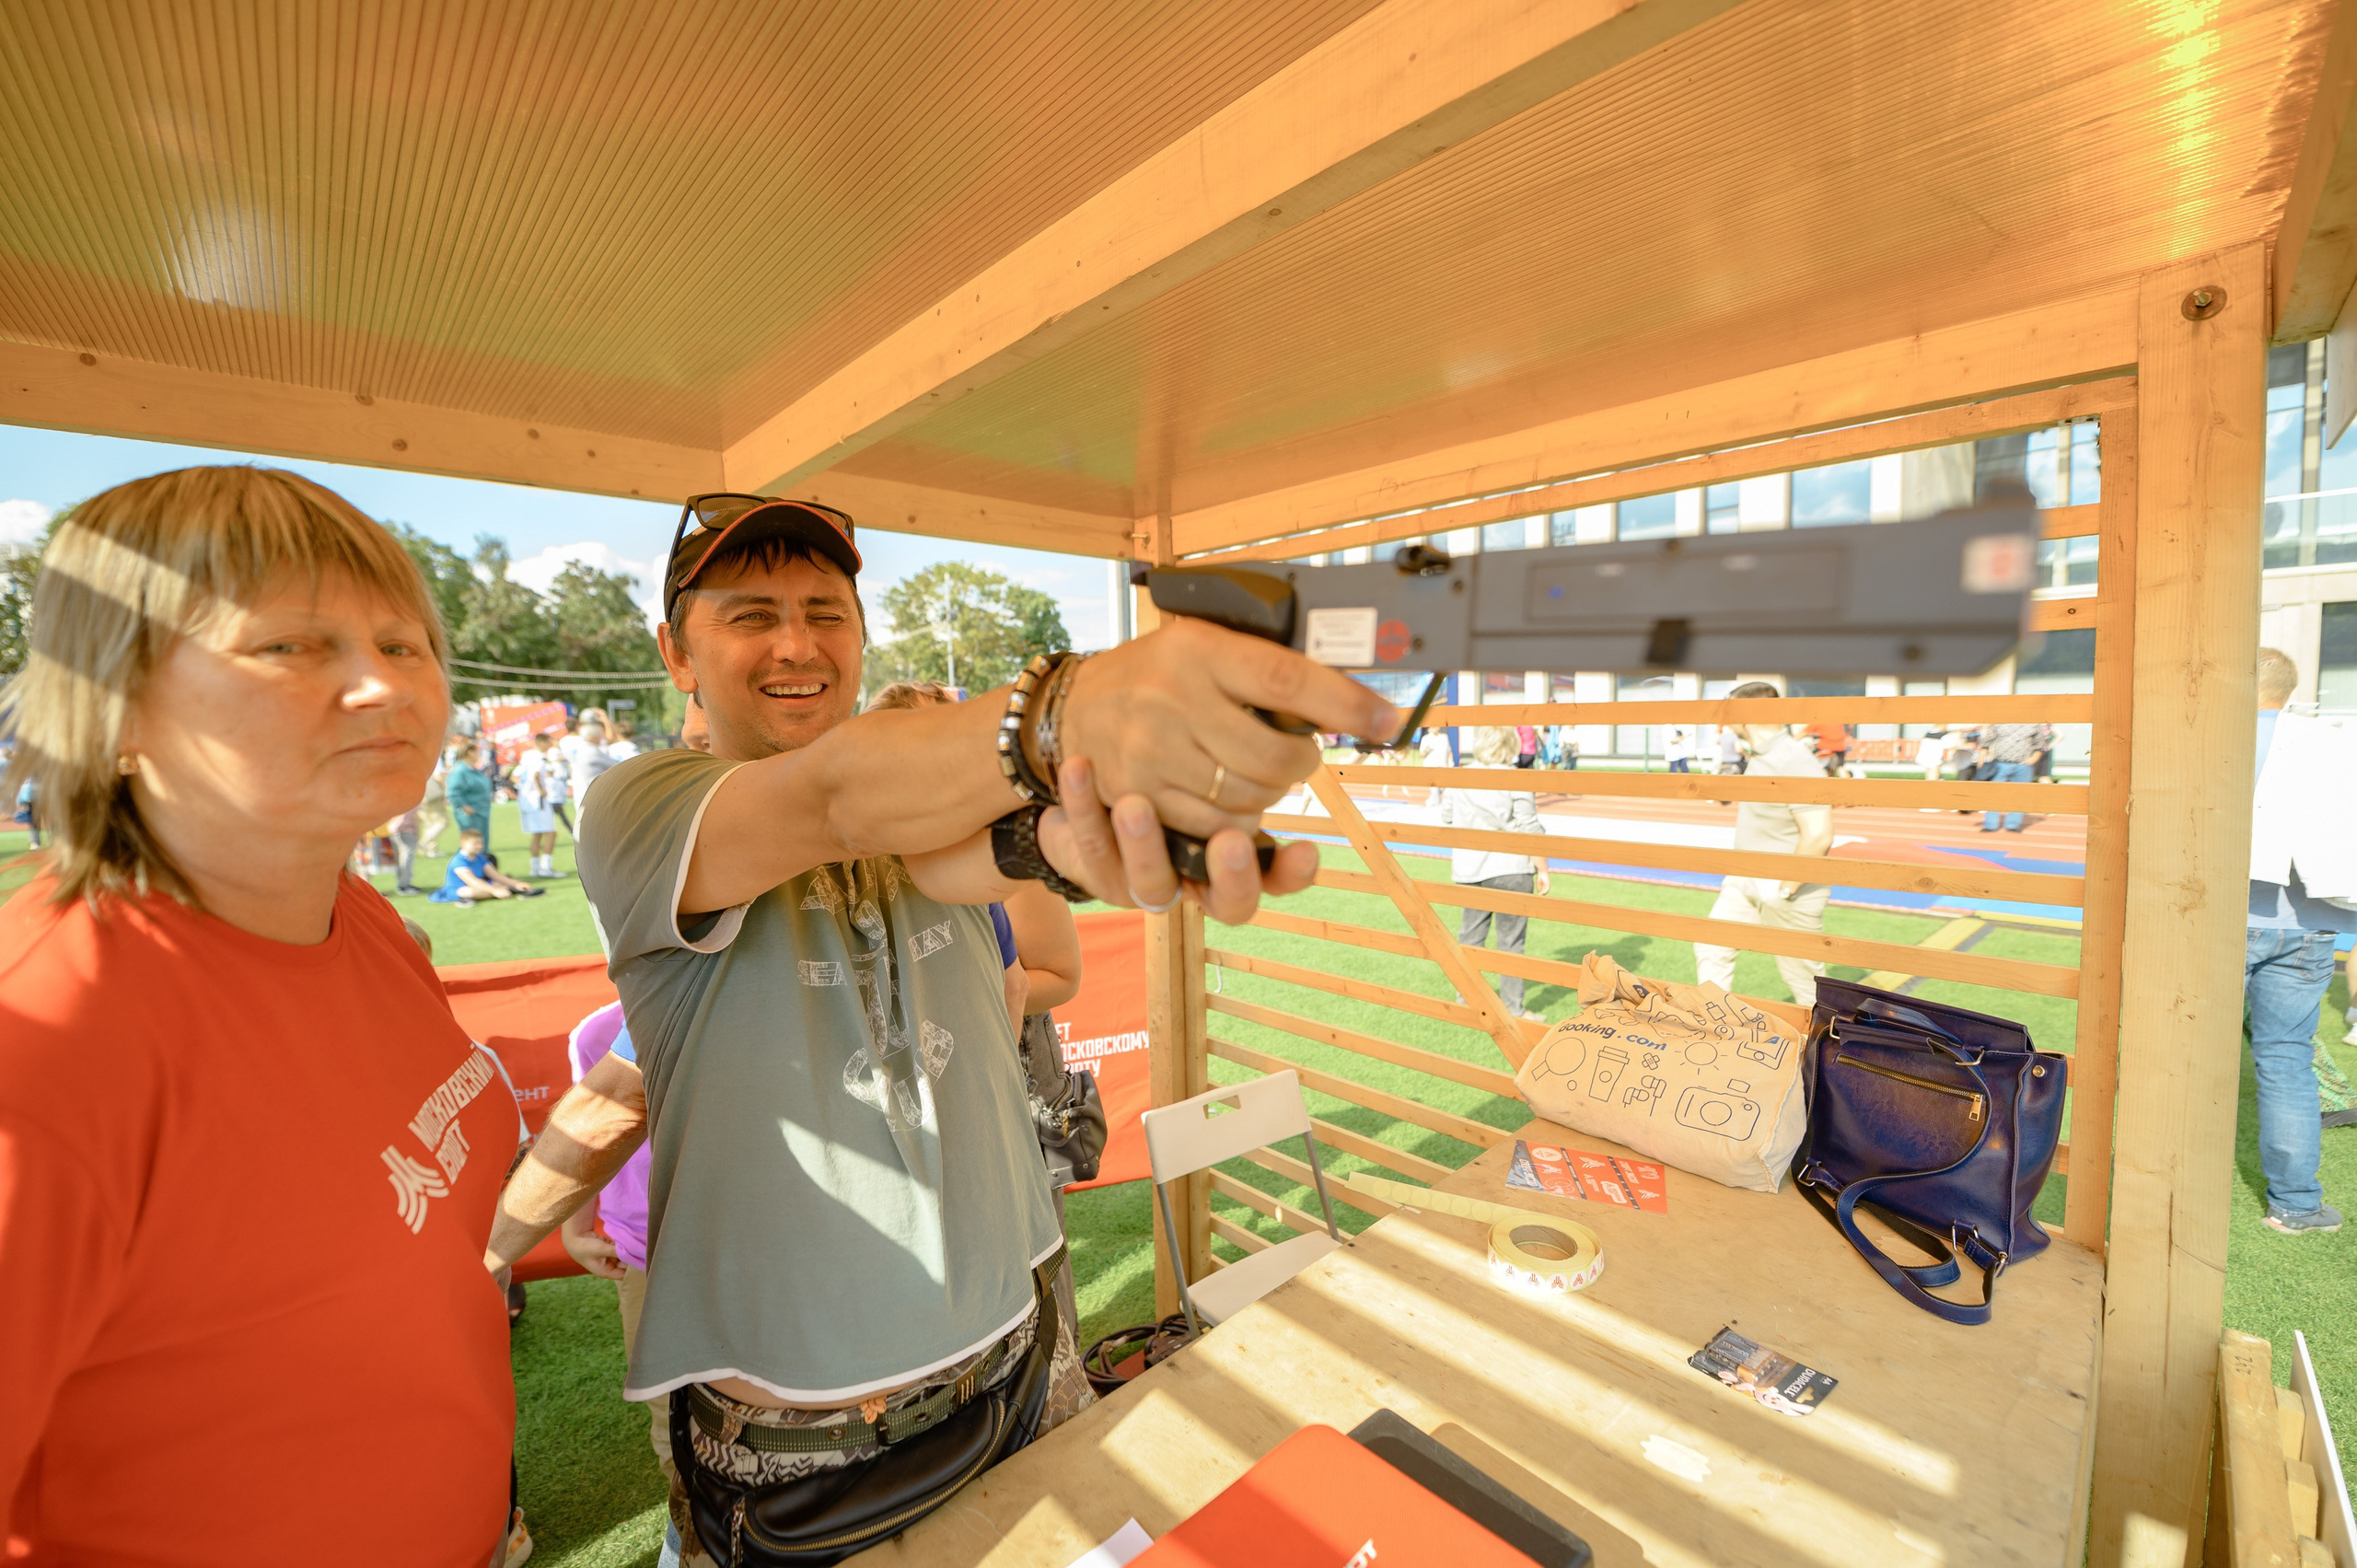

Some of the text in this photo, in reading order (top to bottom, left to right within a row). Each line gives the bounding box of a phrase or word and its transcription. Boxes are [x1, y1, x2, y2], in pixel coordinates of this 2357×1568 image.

[1054, 1022, 1072, 1041] ЕТ
[1060, 1030, 1150, 1062] ОСКОВСКОМУ
[407, 1042, 495, 1153] МОСКОВСКИЙ
[514, 1086, 551, 1102] ент
[435, 1118, 470, 1186] СПОРТ
[1783, 1367, 1817, 1399] DURACELL
